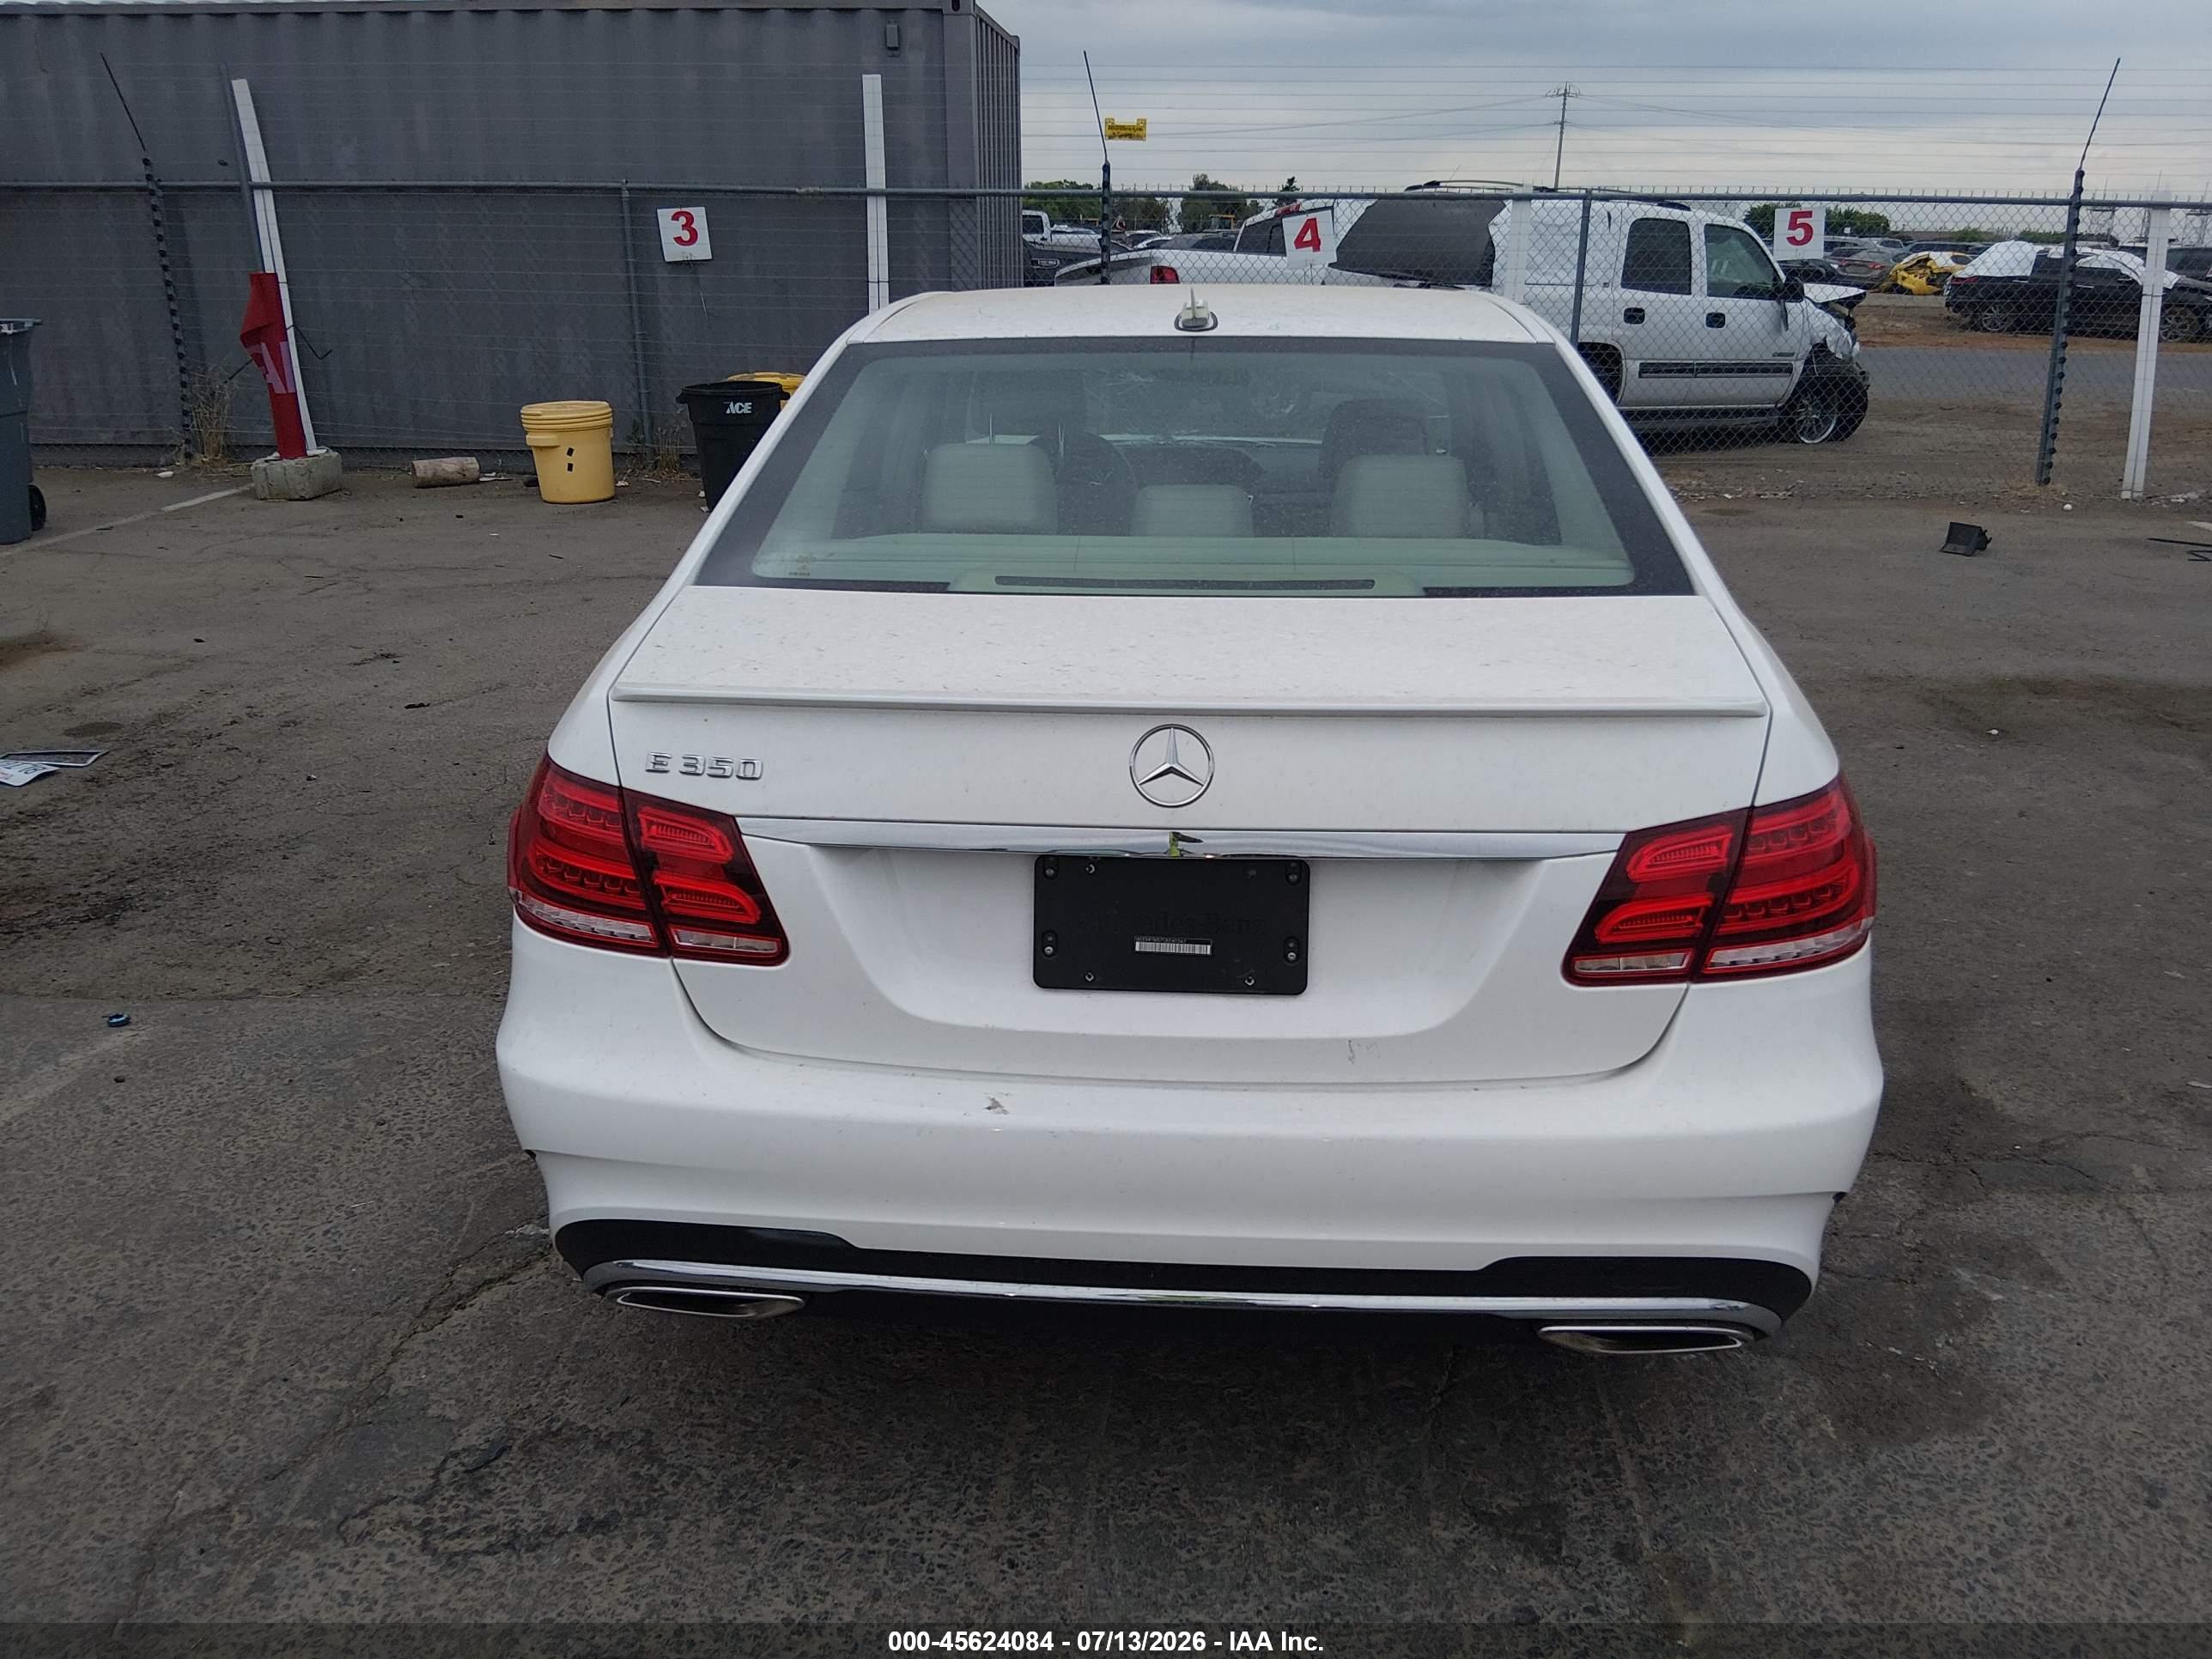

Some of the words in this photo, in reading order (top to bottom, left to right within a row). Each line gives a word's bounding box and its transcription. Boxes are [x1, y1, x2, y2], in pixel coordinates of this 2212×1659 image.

[671, 210, 699, 246] 3
[1294, 217, 1322, 252] 4
[1786, 210, 1814, 246] 5
[722, 401, 753, 414] ACE
[646, 751, 672, 773] E
[679, 754, 763, 781] 350
